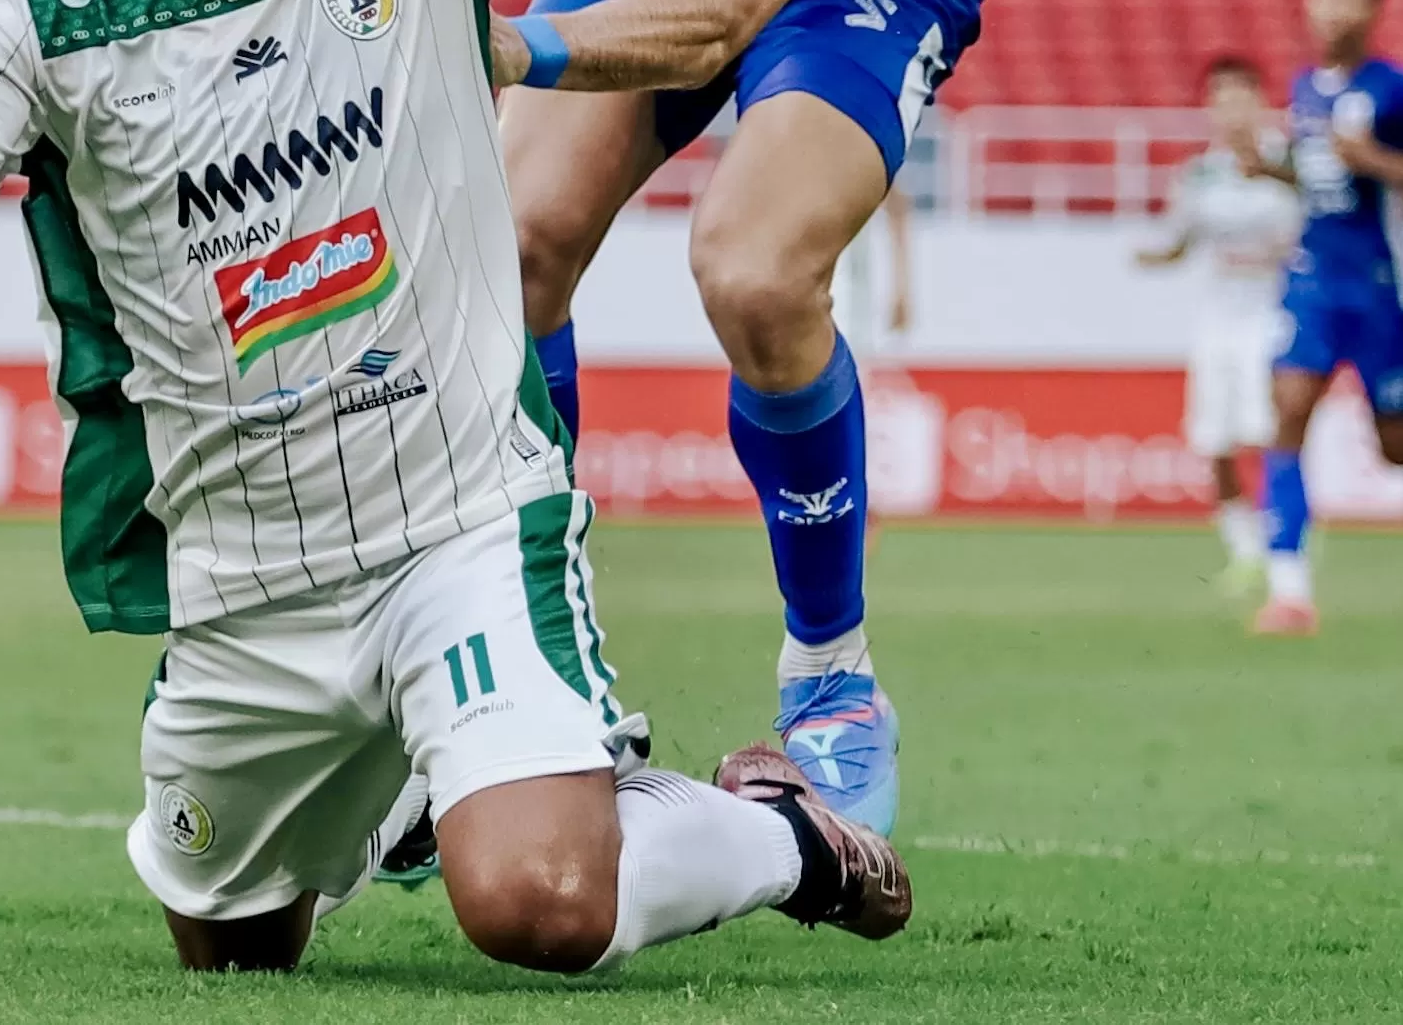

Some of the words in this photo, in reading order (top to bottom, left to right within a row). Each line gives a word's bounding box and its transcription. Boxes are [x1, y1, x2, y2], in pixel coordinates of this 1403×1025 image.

[113, 82, 176, 109] scorelab
[186, 217, 281, 267] AMMAN
[333, 367, 424, 409] ITHACA
[443, 631, 497, 709] 11
